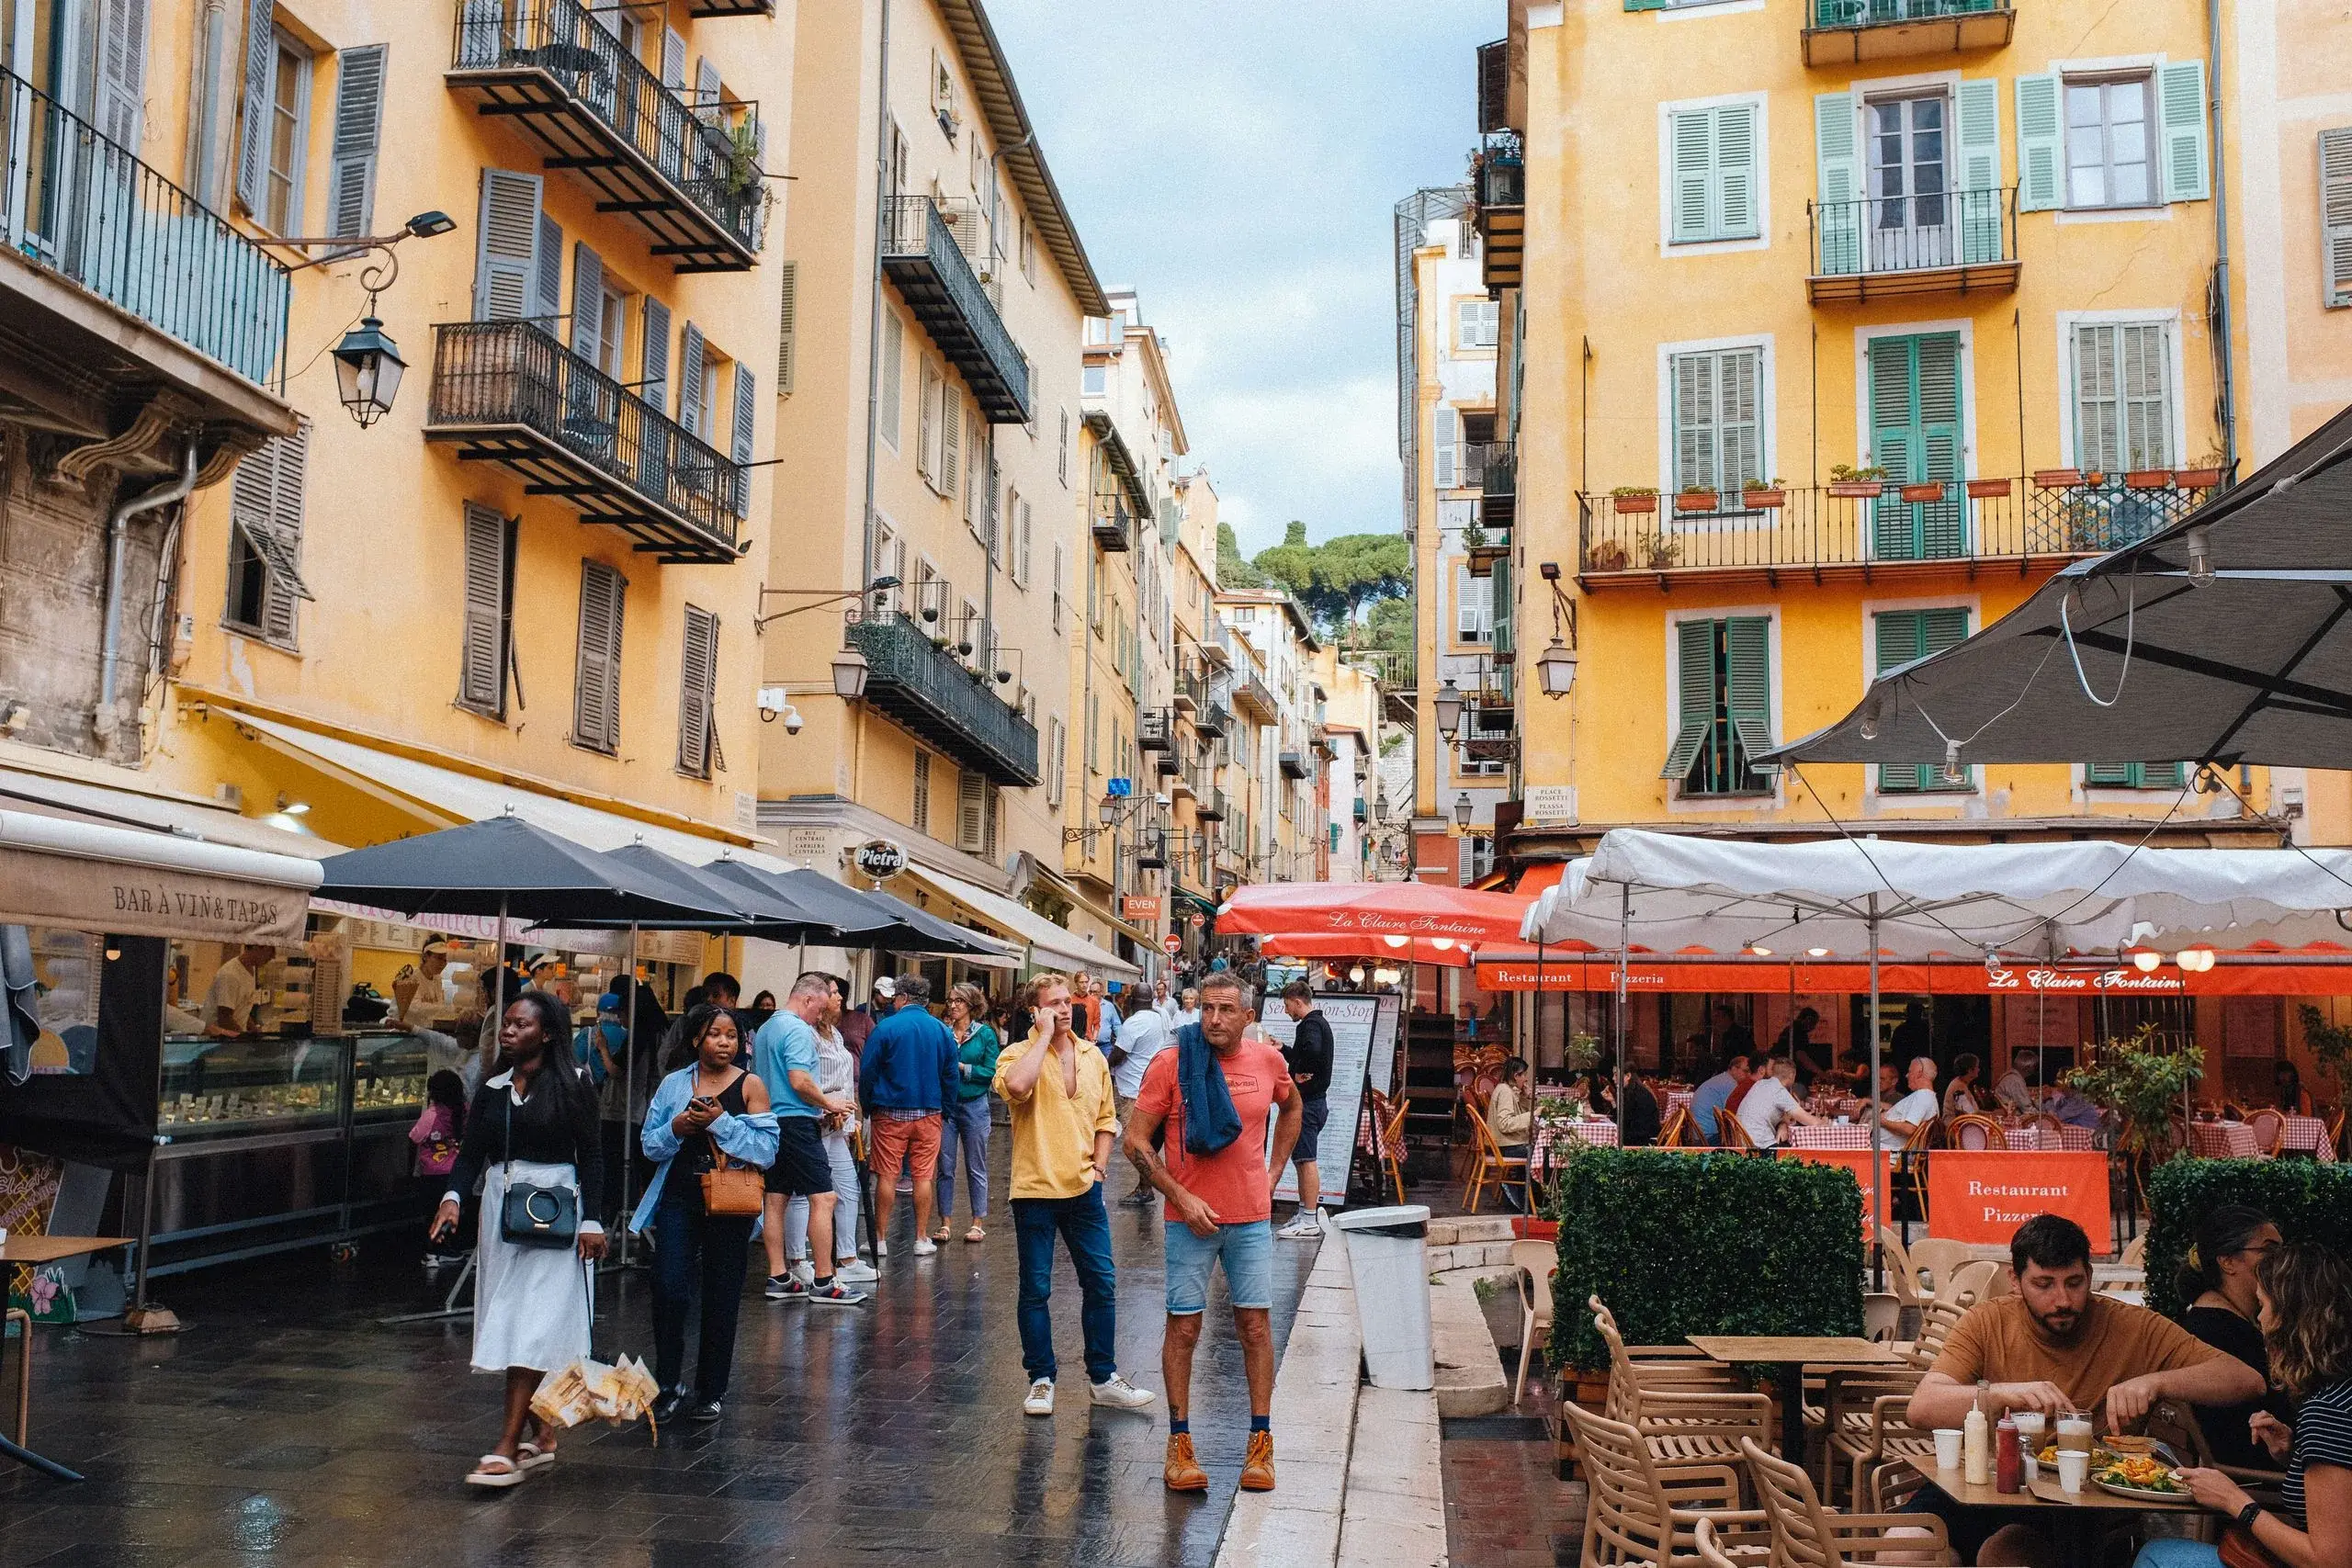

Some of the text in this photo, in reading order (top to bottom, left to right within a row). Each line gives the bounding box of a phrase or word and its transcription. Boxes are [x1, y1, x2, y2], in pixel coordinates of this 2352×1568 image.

[858, 849, 902, 867] Pietra
[114, 884, 277, 925] BAR À VIN & TAPAS
[1128, 900, 1156, 909] EVEN
[1328, 911, 1487, 935] La Claire Fontaine
[1498, 971, 1665, 984] Restaurant Pzzeria
[1987, 970, 2019, 988] La
[2027, 969, 2086, 989] Claire
[1968, 1180, 2068, 1197] Restaurant
